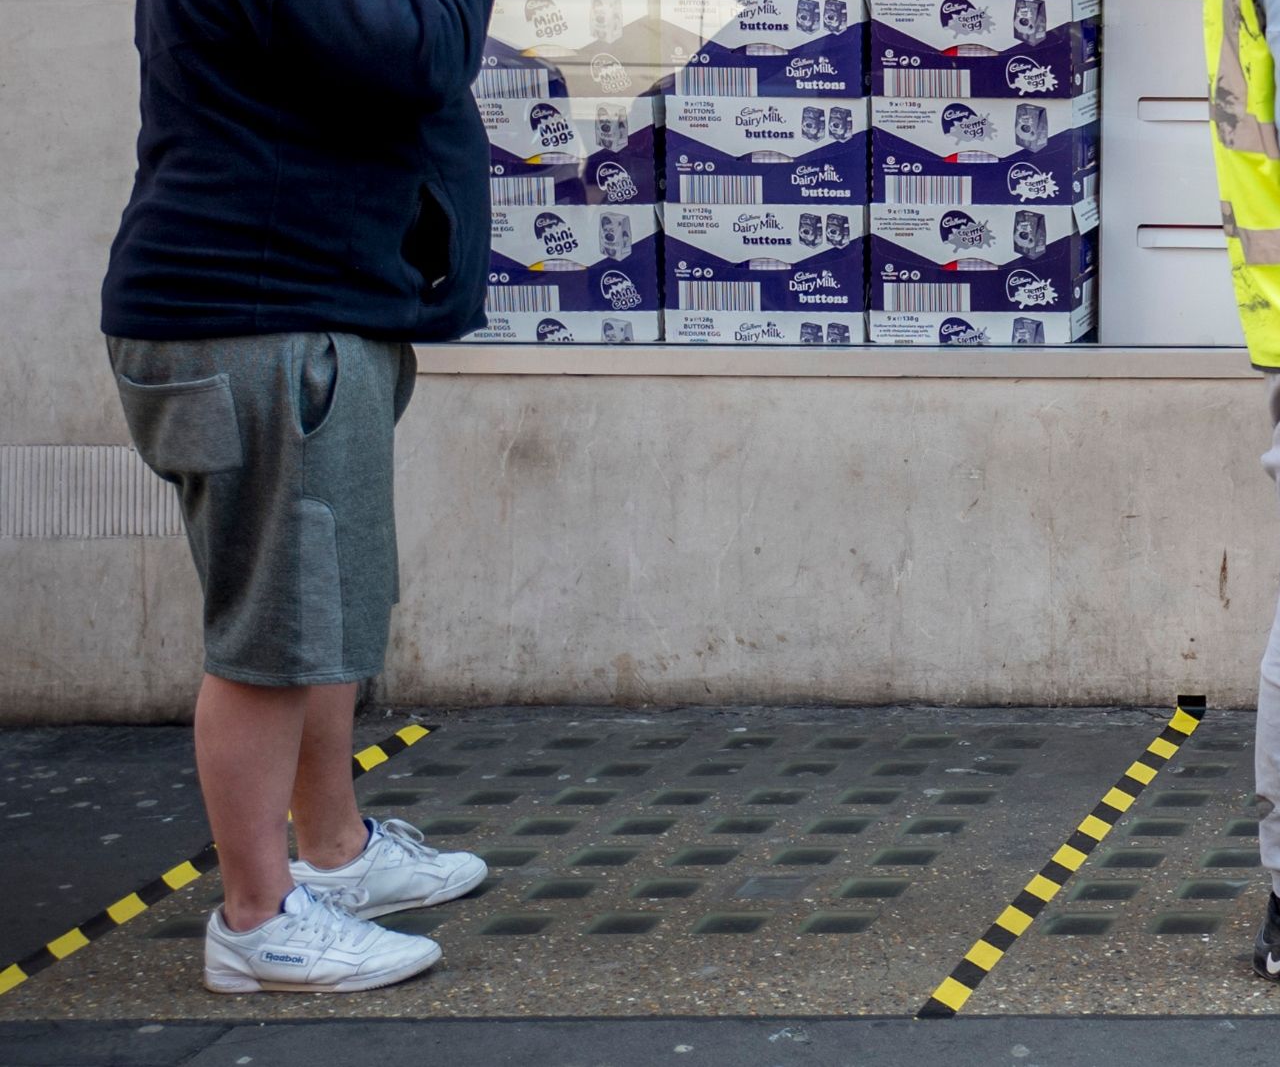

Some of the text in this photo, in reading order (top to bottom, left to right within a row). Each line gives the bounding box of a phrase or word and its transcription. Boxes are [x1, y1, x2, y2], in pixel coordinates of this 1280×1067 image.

[796, 79, 845, 90] buttons
[540, 119, 569, 138] Mini
[745, 129, 794, 139] buttons
[541, 131, 574, 147] eggs
[791, 175, 818, 186] Dairy
[801, 187, 851, 198] buttons
[733, 222, 758, 233] Dairy
[957, 225, 986, 237] creme
[543, 227, 573, 246] Mini
[743, 236, 792, 245] buttons
[962, 234, 982, 245] egg
[546, 238, 579, 255] eggs
[265, 952, 304, 965] Reebok
